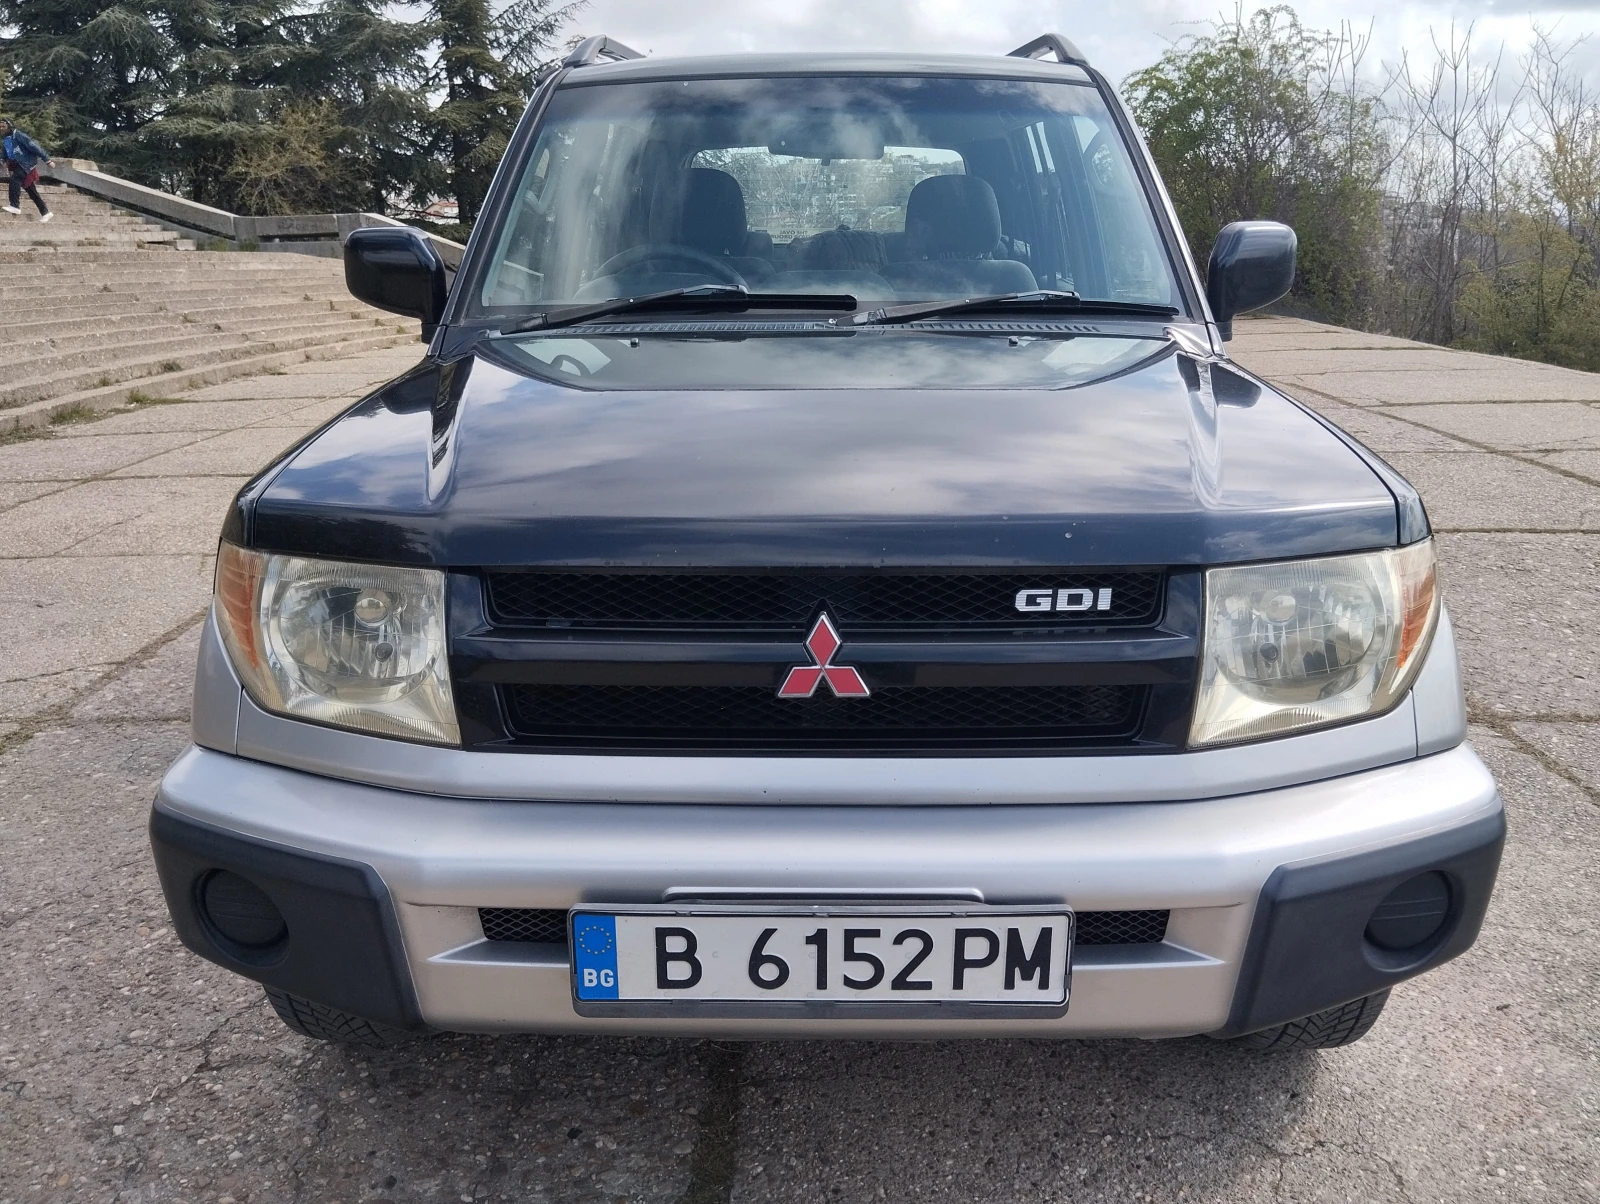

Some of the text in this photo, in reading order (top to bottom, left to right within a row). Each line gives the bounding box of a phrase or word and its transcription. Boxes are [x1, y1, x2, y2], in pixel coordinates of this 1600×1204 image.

[1015, 588, 1112, 611] GDI
[655, 926, 1053, 991] B 6152 PM
[583, 968, 615, 988] BG
